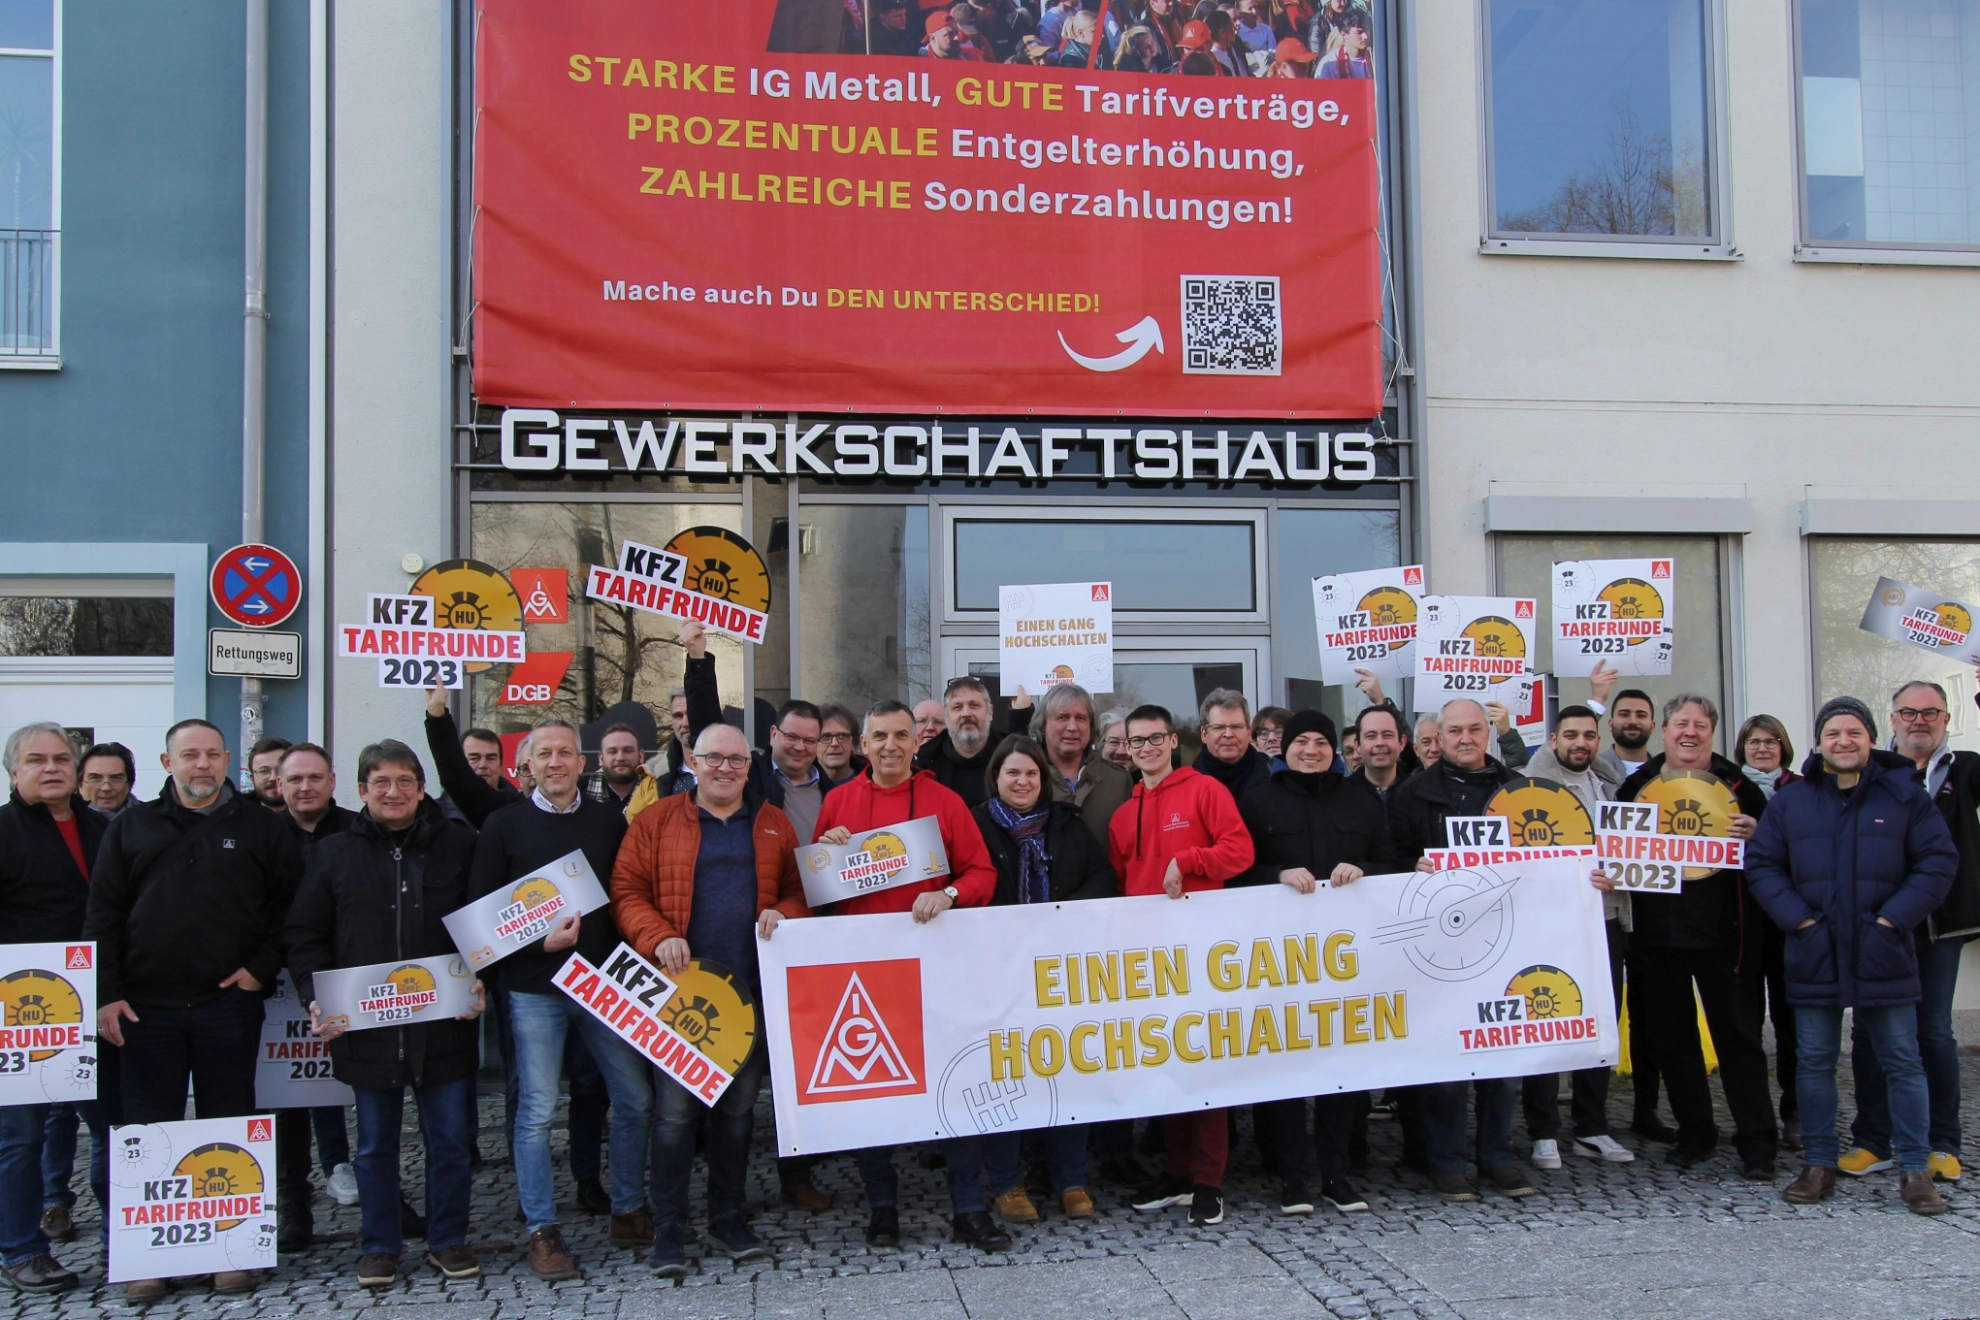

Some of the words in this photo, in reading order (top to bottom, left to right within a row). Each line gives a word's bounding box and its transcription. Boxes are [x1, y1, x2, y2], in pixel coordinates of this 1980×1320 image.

[568, 54, 736, 94] STARKE
[750, 67, 790, 98] IG
[804, 71, 942, 107] Metall,
[955, 77, 1064, 112] GUTE
[1075, 84, 1350, 129] Tarifverträge,
[628, 113, 938, 157] PROZENTUALE
[952, 129, 1305, 179] Entgelterhöhung,
[639, 166, 912, 210] ZAHLREICHE
[924, 181, 1293, 230] Sonderzahlungen!
[603, 280, 696, 303] Mache
[704, 284, 772, 306] auch
[781, 287, 817, 307] Du
[827, 288, 884, 309] DEN
[894, 290, 1100, 313] UNTERSCHIED!
[501, 408, 1376, 481] GEWERKSCHAFTSHAUS
[624, 546, 681, 584] KFZ
[372, 597, 428, 626] KFZ
[594, 570, 763, 639] TARIFRUNDE
[1576, 604, 1607, 619] KFZ
[1016, 619, 1055, 632] EINEN
[1058, 617, 1095, 630] GANG
[1338, 613, 1368, 630] KFZ
[1914, 609, 1937, 623] KFZ
[1560, 621, 1661, 637] TARIFRUNDE
[1901, 616, 1965, 644] TARIFRUNDE
[1909, 631, 1938, 647] 2023
[344, 628, 521, 658] TARIFRUNDE
[1005, 632, 1107, 648] HOCHSCHALTEN
[1440, 640, 1471, 655] KFZ
[1581, 638, 1624, 653] 2023
[216, 645, 293, 665] Rettungsweg
[1346, 644, 1387, 661] 2023
[384, 658, 457, 686] 2023
[1423, 657, 1523, 674] TARIFRUNDE
[1443, 675, 1487, 690] 2023
[507, 684, 551, 702] DGB
[1600, 805, 1651, 831] KFZ
[1677, 817, 1696, 830] HU
[1451, 820, 1503, 846] KFZ
[1528, 828, 1548, 841] HU
[847, 853, 870, 867] KFZ
[1595, 835, 1740, 865] ARIFRUNDE
[840, 856, 908, 881] TARIFRUNDE
[1606, 862, 1676, 889] 2023
[857, 874, 887, 889] 2023
[496, 897, 565, 938] TARIFRUNDE
[500, 902, 524, 922] KFZ
[516, 919, 547, 941] 2023
[1034, 944, 1191, 1009] EINEN
[1206, 929, 1360, 992] GANG
[605, 950, 669, 1009] KFZ
[371, 984, 395, 998] KFZ
[360, 991, 436, 1012] TARIFRUNDE
[1477, 999, 1522, 1024] KFZ
[22, 1010, 40, 1021] HU
[377, 1007, 411, 1021] 2023
[286, 1020, 321, 1038] KF
[562, 958, 727, 1101] TARIFRUNDE
[988, 989, 1409, 1083] HOCHSCHALTEN
[1459, 1018, 1597, 1050] TARIFRUNDE
[265, 1041, 333, 1059] TARIFR
[76, 1068, 91, 1079] 23
[290, 1060, 335, 1079] 202
[128, 1149, 140, 1159] 23
[144, 1178, 188, 1201] KFZ
[121, 1196, 262, 1226] TARIFRUNDE
[151, 1222, 212, 1247] 2023
[258, 1237, 272, 1247] 23
